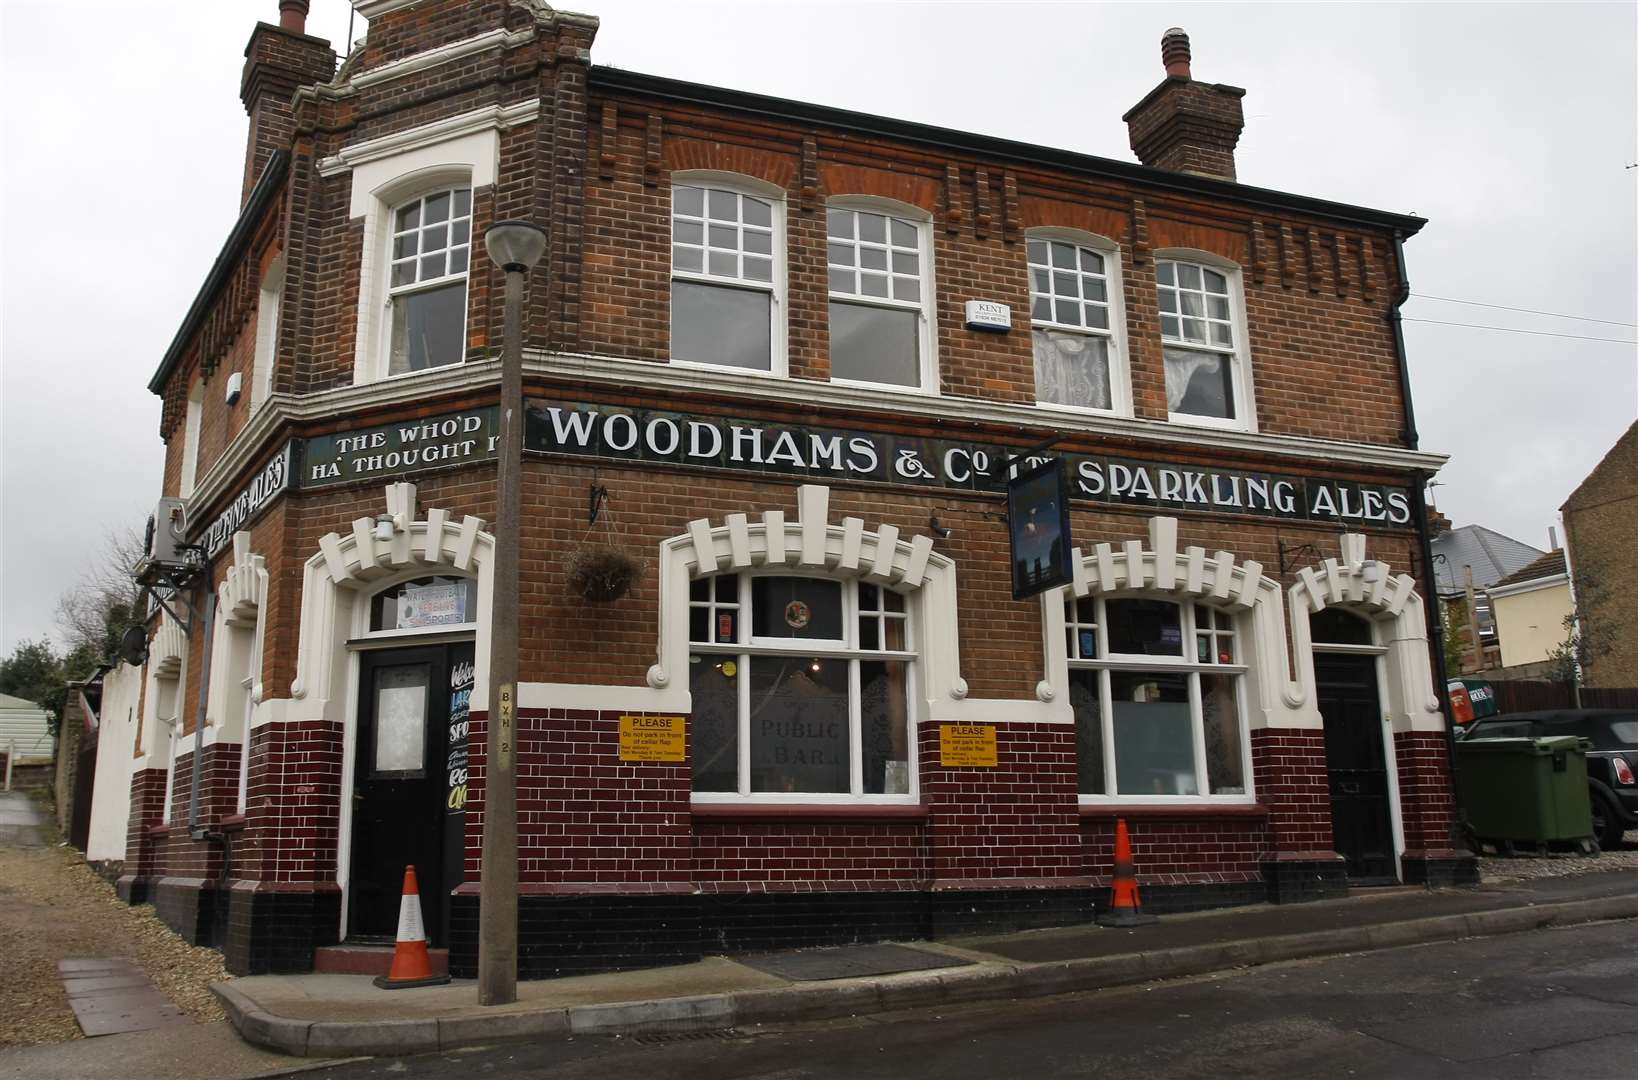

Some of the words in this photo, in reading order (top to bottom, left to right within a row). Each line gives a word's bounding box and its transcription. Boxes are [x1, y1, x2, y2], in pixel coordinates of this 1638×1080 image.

[336, 432, 386, 454] THE
[399, 414, 482, 444] WHO'D
[352, 440, 476, 473] THOUGHT
[487, 434, 501, 452] I
[547, 407, 878, 473] WOODHAMS
[895, 450, 935, 478] &
[1078, 460, 1295, 512] SPARKLING
[1311, 485, 1411, 524] ALES
[249, 453, 286, 514] ALES
[633, 718, 672, 727] PLEASE
[761, 719, 839, 739] PUBLIC
[951, 726, 985, 736] PLEASE
[775, 745, 824, 765] BAR
